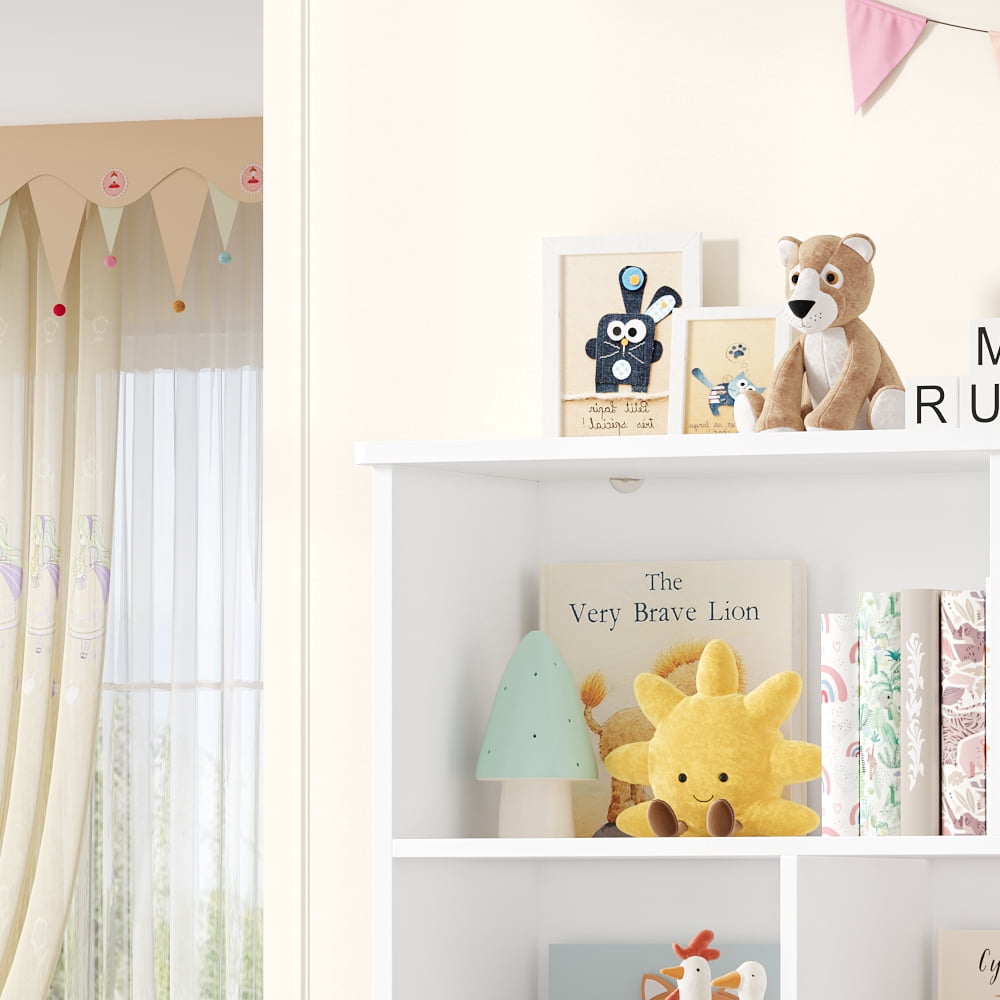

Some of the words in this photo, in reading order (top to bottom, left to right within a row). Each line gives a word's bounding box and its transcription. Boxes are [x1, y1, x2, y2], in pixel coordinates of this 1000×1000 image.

[645, 571, 683, 591] The
[569, 603, 622, 632] Very
[634, 602, 697, 623] Brave
[708, 600, 760, 621] Lion
